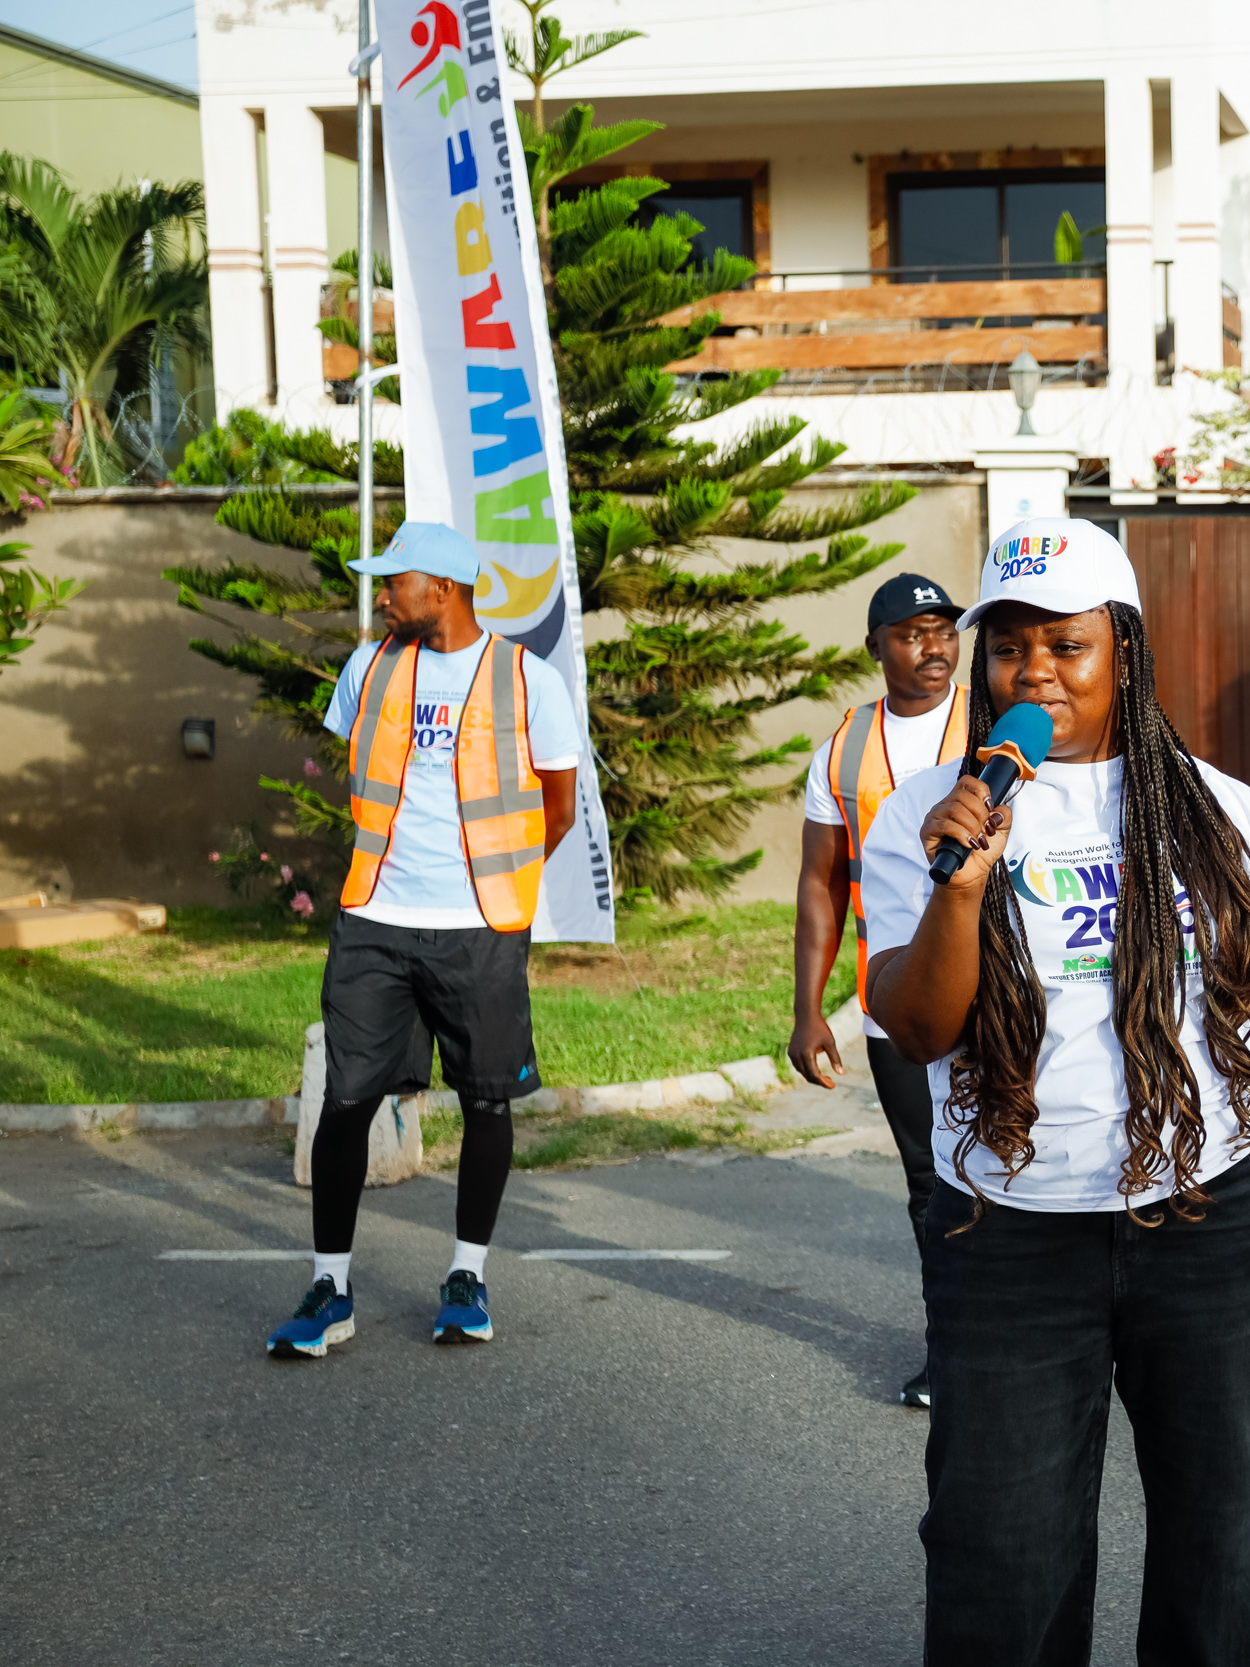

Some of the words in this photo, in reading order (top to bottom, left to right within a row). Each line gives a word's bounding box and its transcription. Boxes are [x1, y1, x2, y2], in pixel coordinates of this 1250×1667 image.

[1001, 537, 1050, 562] AWARE
[1000, 556, 1046, 583] 2026
[1048, 849, 1083, 857] Autism
[1085, 844, 1110, 854] Walk
[1112, 841, 1122, 849] fo
[1045, 855, 1104, 864] Recognition
[1076, 970, 1098, 980] SPROUT
